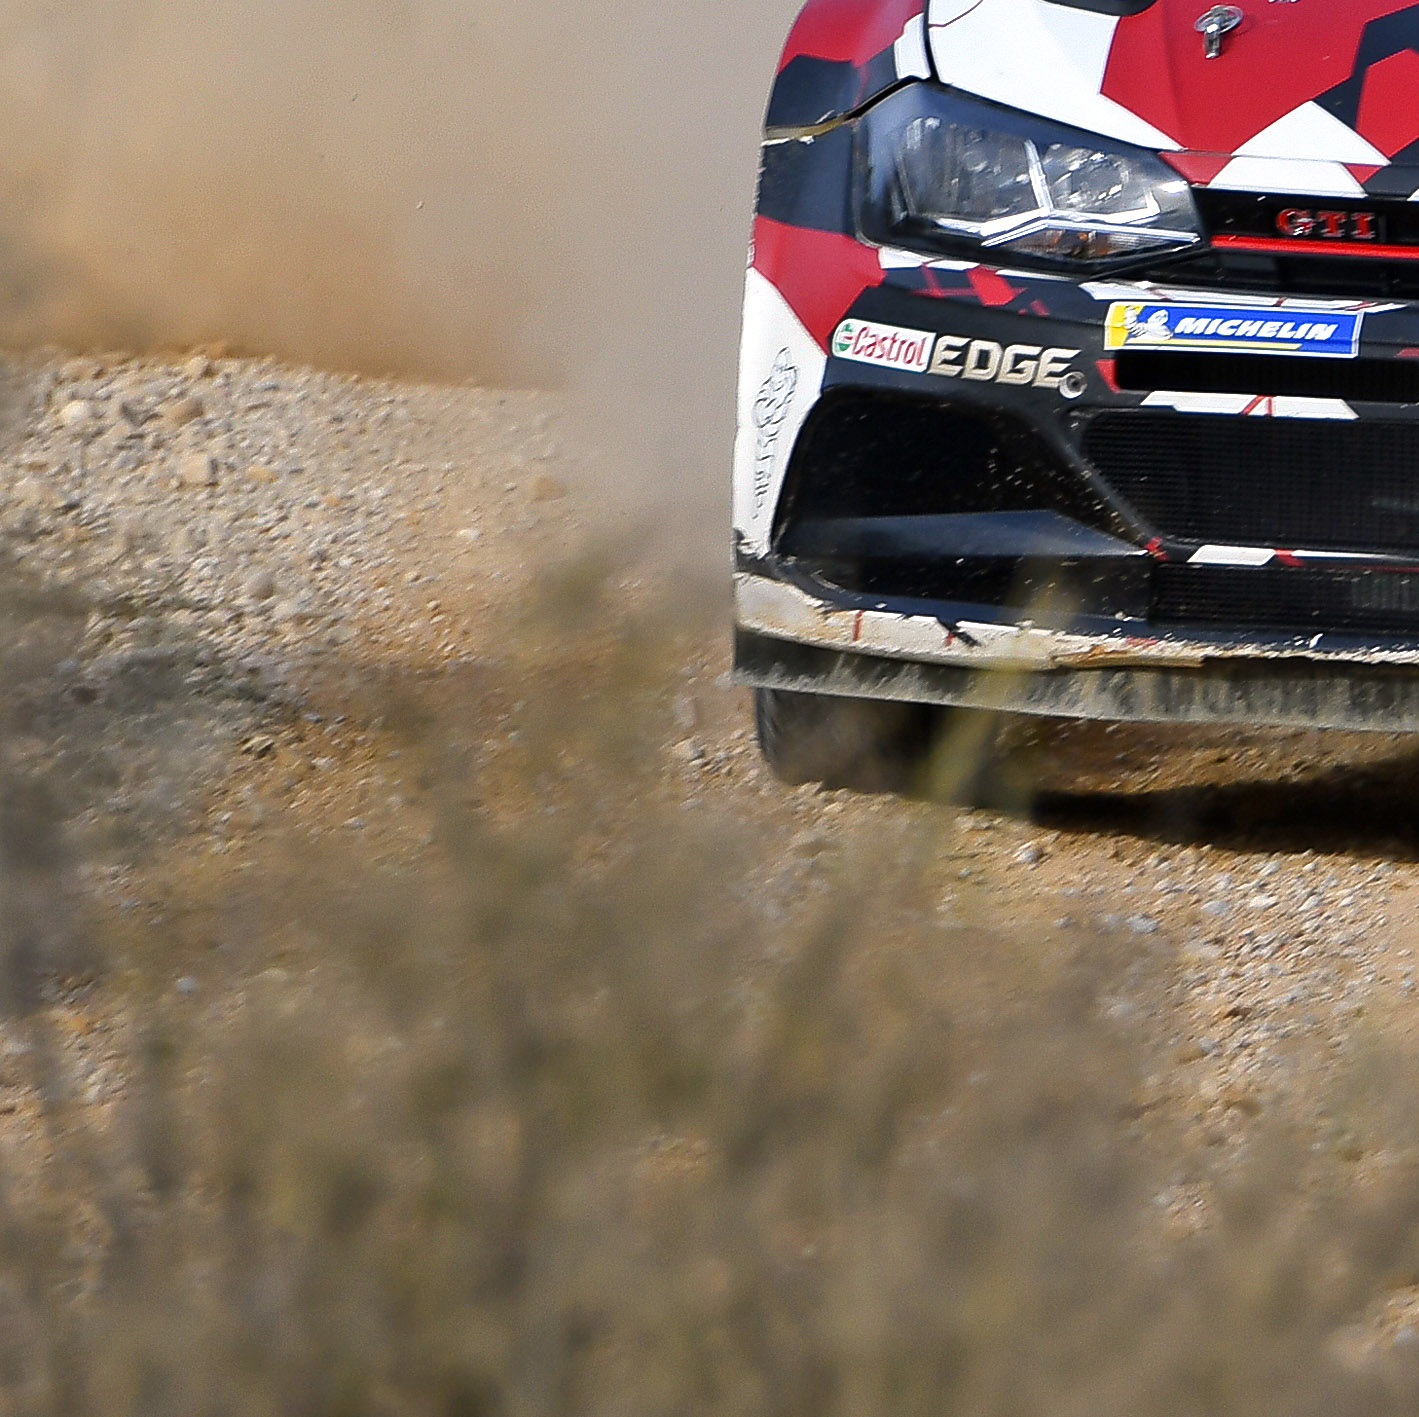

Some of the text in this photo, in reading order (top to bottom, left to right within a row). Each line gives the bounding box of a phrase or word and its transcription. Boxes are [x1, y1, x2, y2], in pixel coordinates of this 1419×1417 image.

[1274, 206, 1376, 240] GTI
[1174, 316, 1339, 341] MICHELIN
[852, 325, 1082, 390] Castrol EDGE
